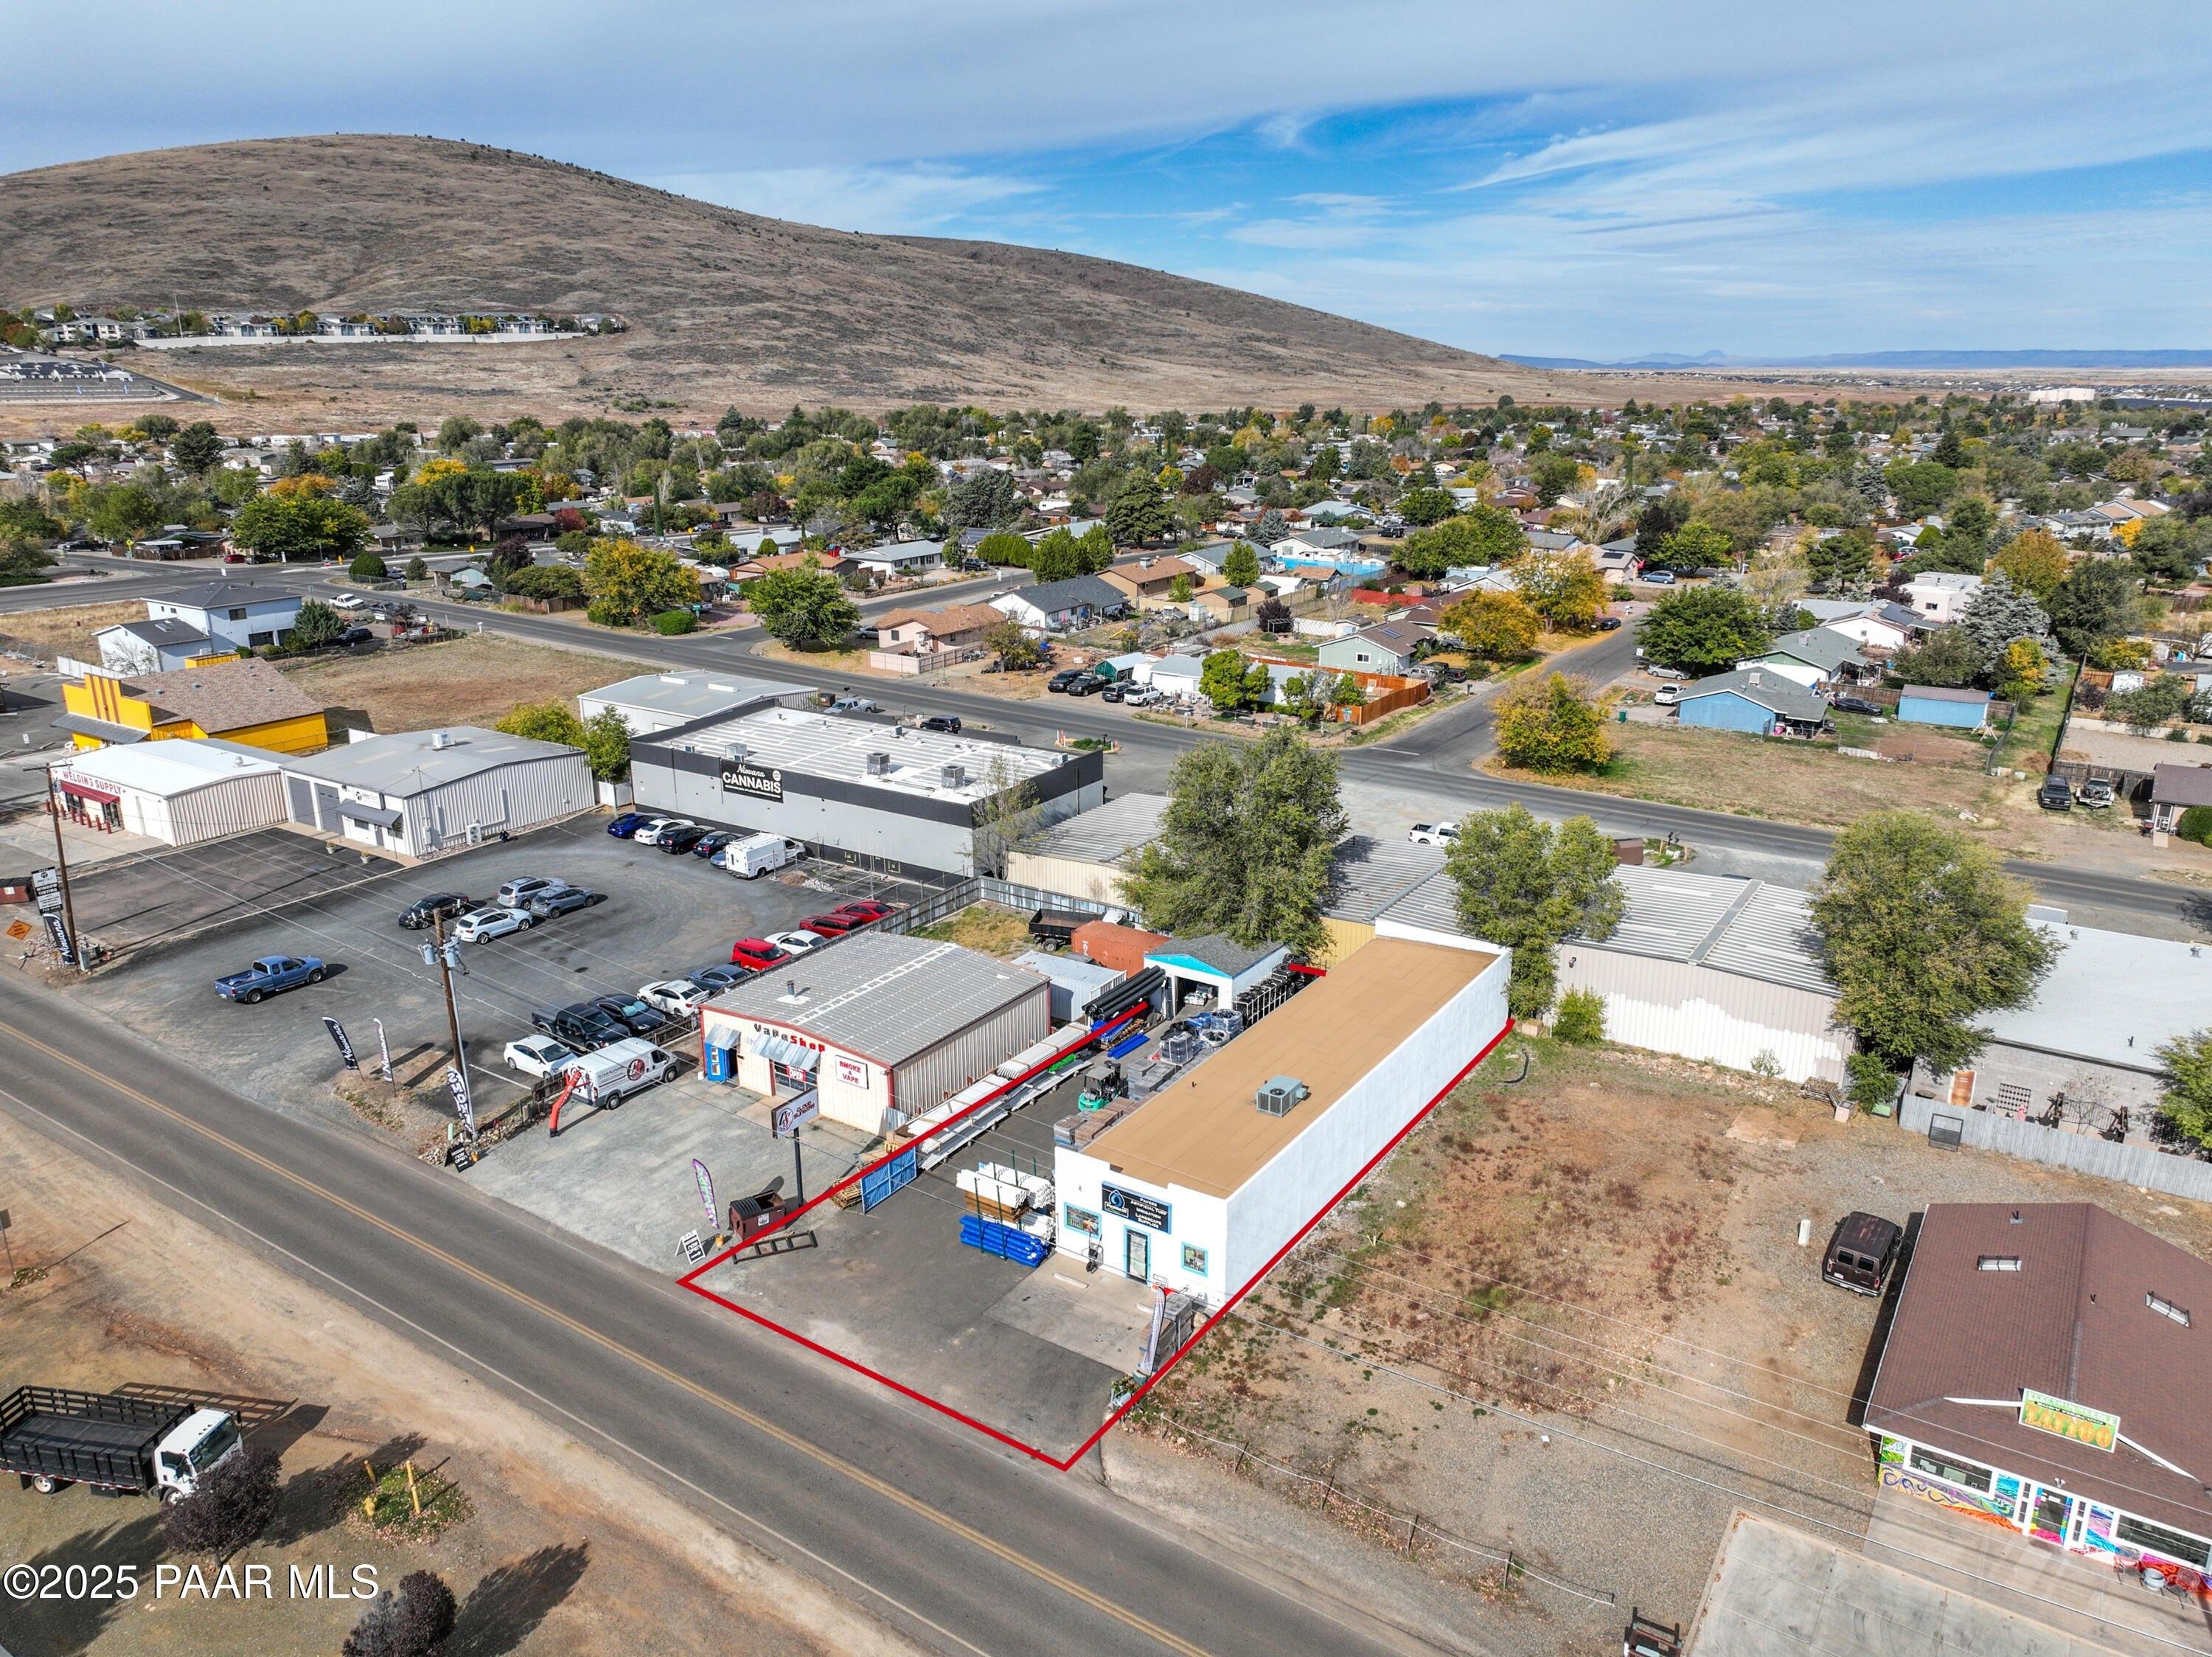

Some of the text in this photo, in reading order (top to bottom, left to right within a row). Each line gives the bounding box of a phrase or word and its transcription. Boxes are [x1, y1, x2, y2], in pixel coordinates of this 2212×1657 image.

[737, 764, 765, 777] Nirvana
[62, 770, 121, 794] WELDING SUPPLY
[723, 771, 782, 793] CANNABIS
[53, 919, 73, 958] Nirvana
[333, 1024, 355, 1062] Nirvana
[378, 1026, 391, 1074] Nirvana
[839, 1060, 861, 1074] SMOKE
[789, 1069, 804, 1082] OPEN
[842, 1073, 859, 1084] VAPE
[1130, 1200, 1155, 1212] ARTIFICIAL
[1140, 1198, 1157, 1206] PAVERS
[1135, 1212, 1161, 1226] LANDSCAPE
[1136, 1207, 1161, 1219] IRRIGATION
[1138, 1217, 1158, 1229] SUPPLIES
[2024, 1403, 2112, 1448] TATTOO
